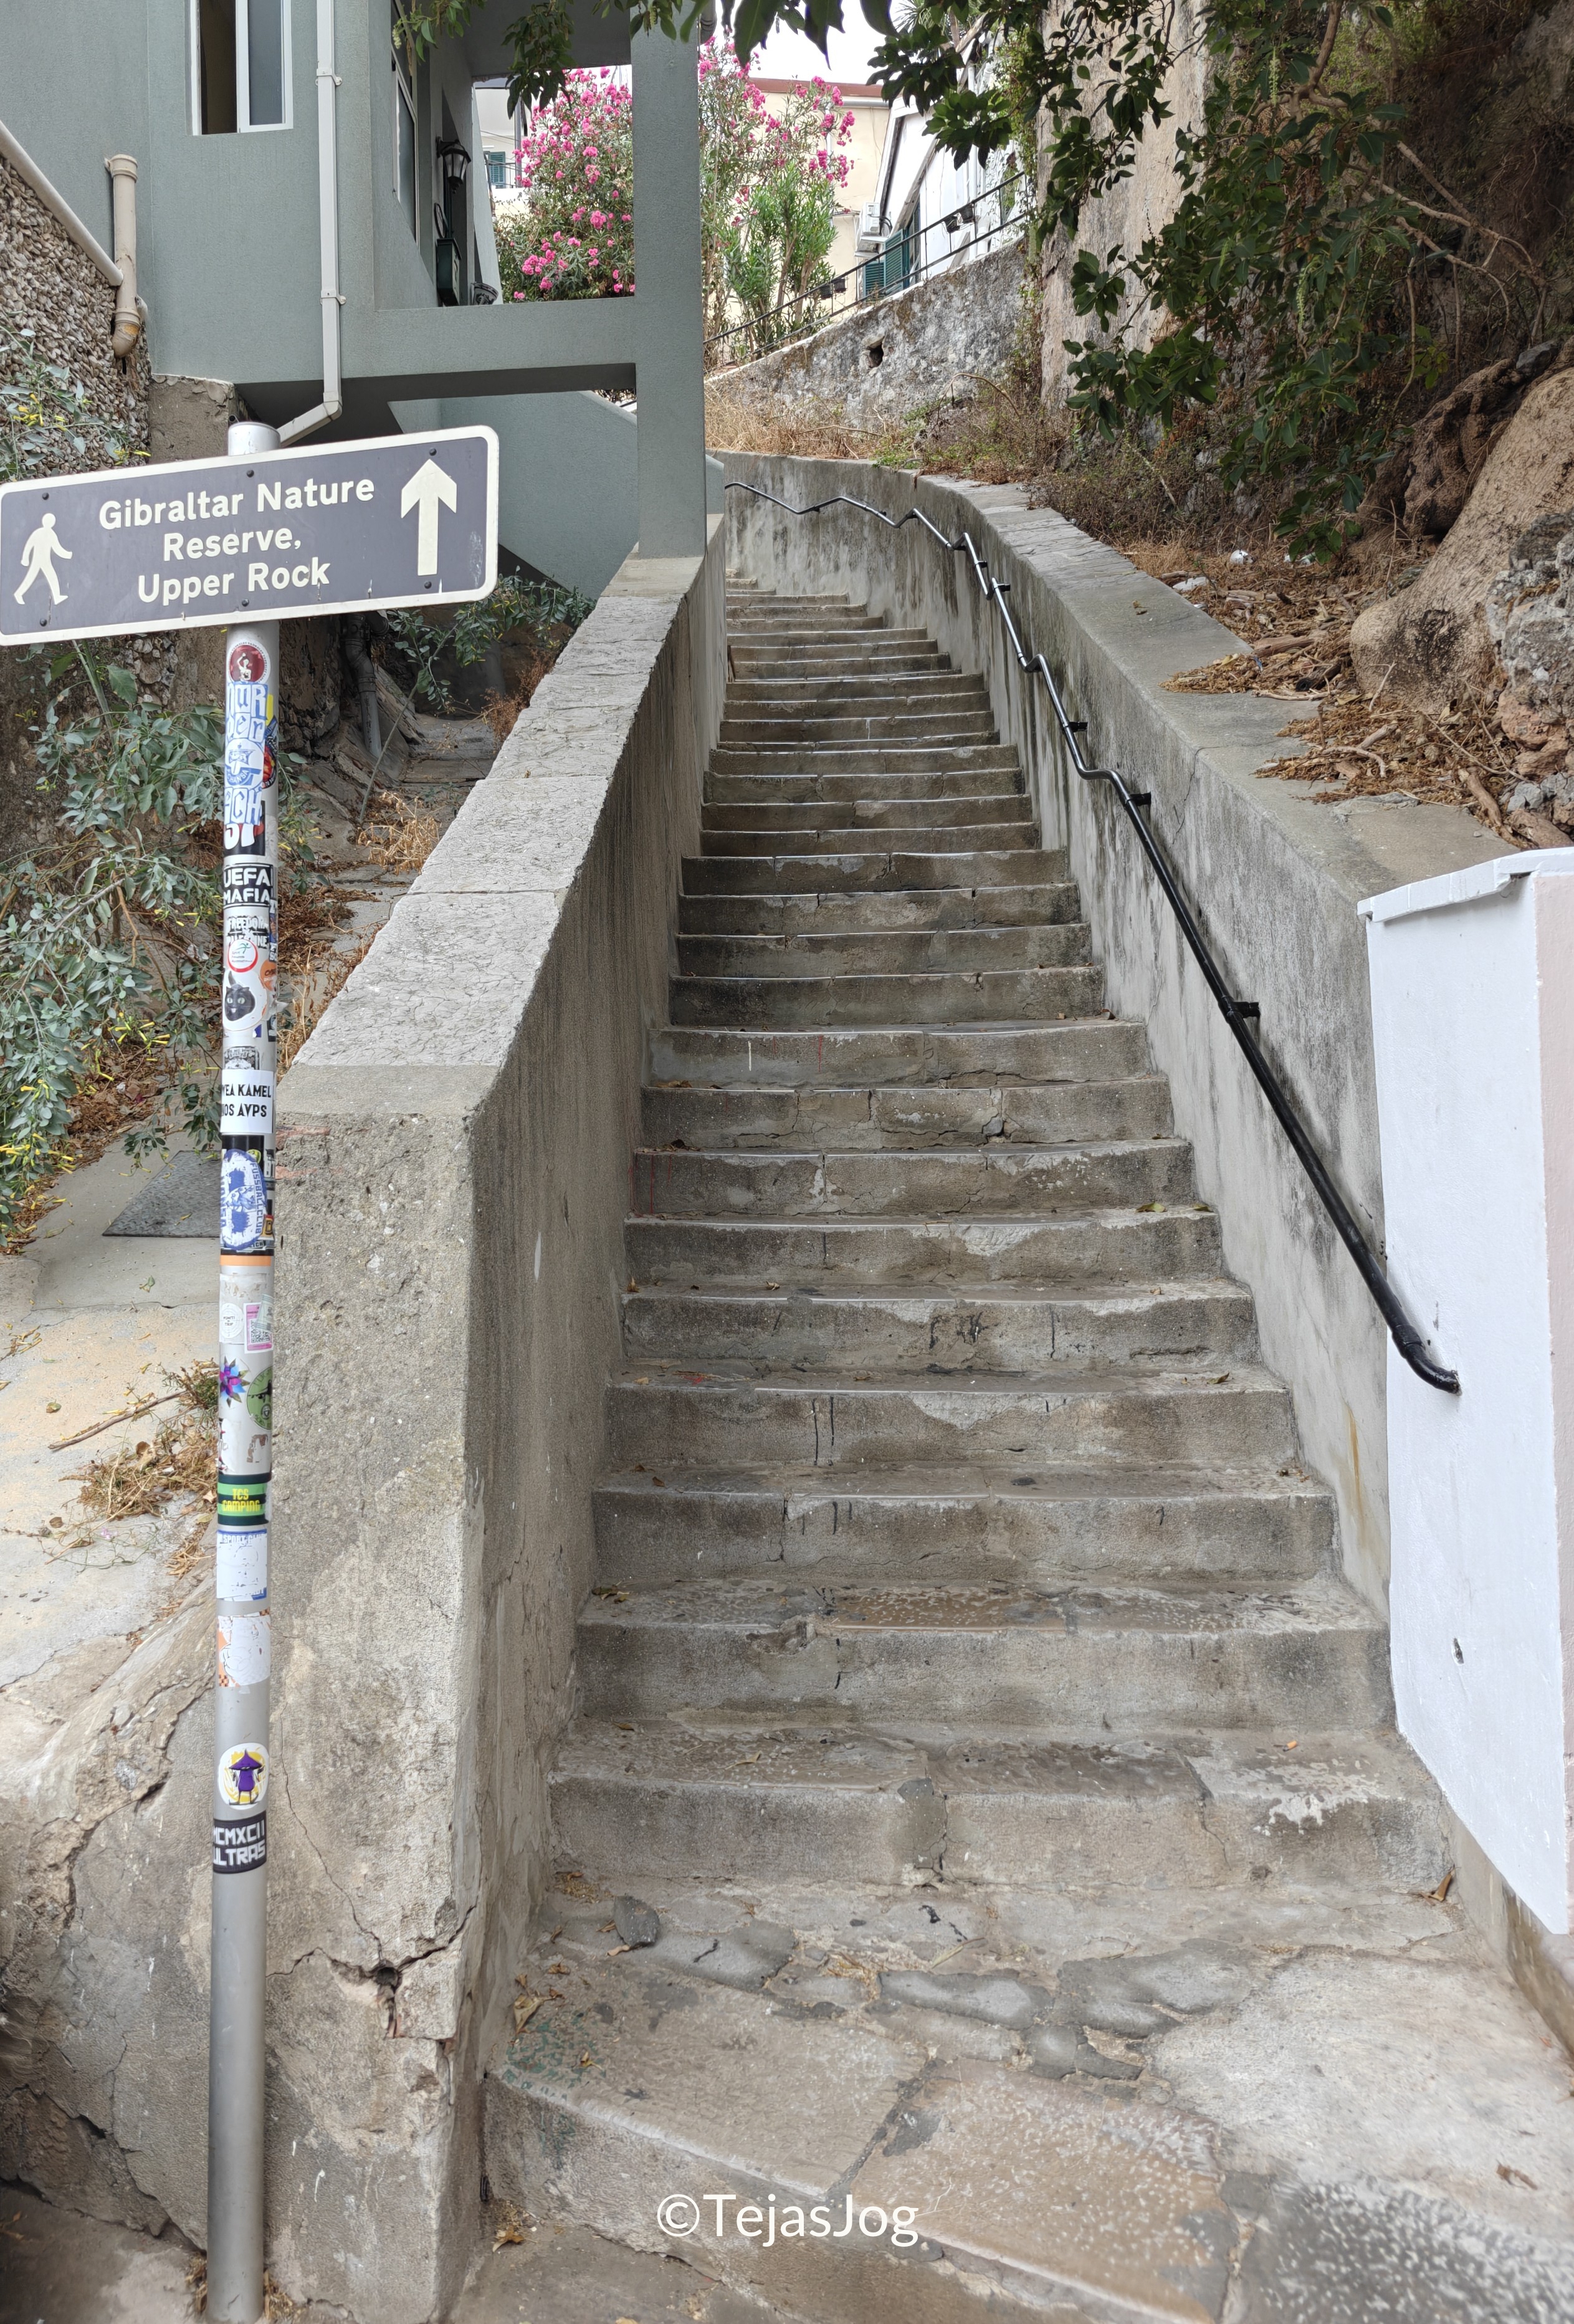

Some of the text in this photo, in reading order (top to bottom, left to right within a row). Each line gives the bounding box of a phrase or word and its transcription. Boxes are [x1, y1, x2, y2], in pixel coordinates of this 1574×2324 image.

[100, 479, 374, 530] Gibraltar Nature
[164, 527, 301, 561] Reserve,
[138, 557, 330, 606] Upper Rock
[223, 868, 270, 888] UEFA
[223, 888, 270, 906] MAFIA
[238, 1083, 272, 1097] KAMEL
[250, 1162, 264, 1234] FUSSBALLCLUB
[221, 1499, 260, 1511] CAMPING
[232, 1488, 249, 1500] TCS
[213, 1839, 265, 1866] ULTRAS
